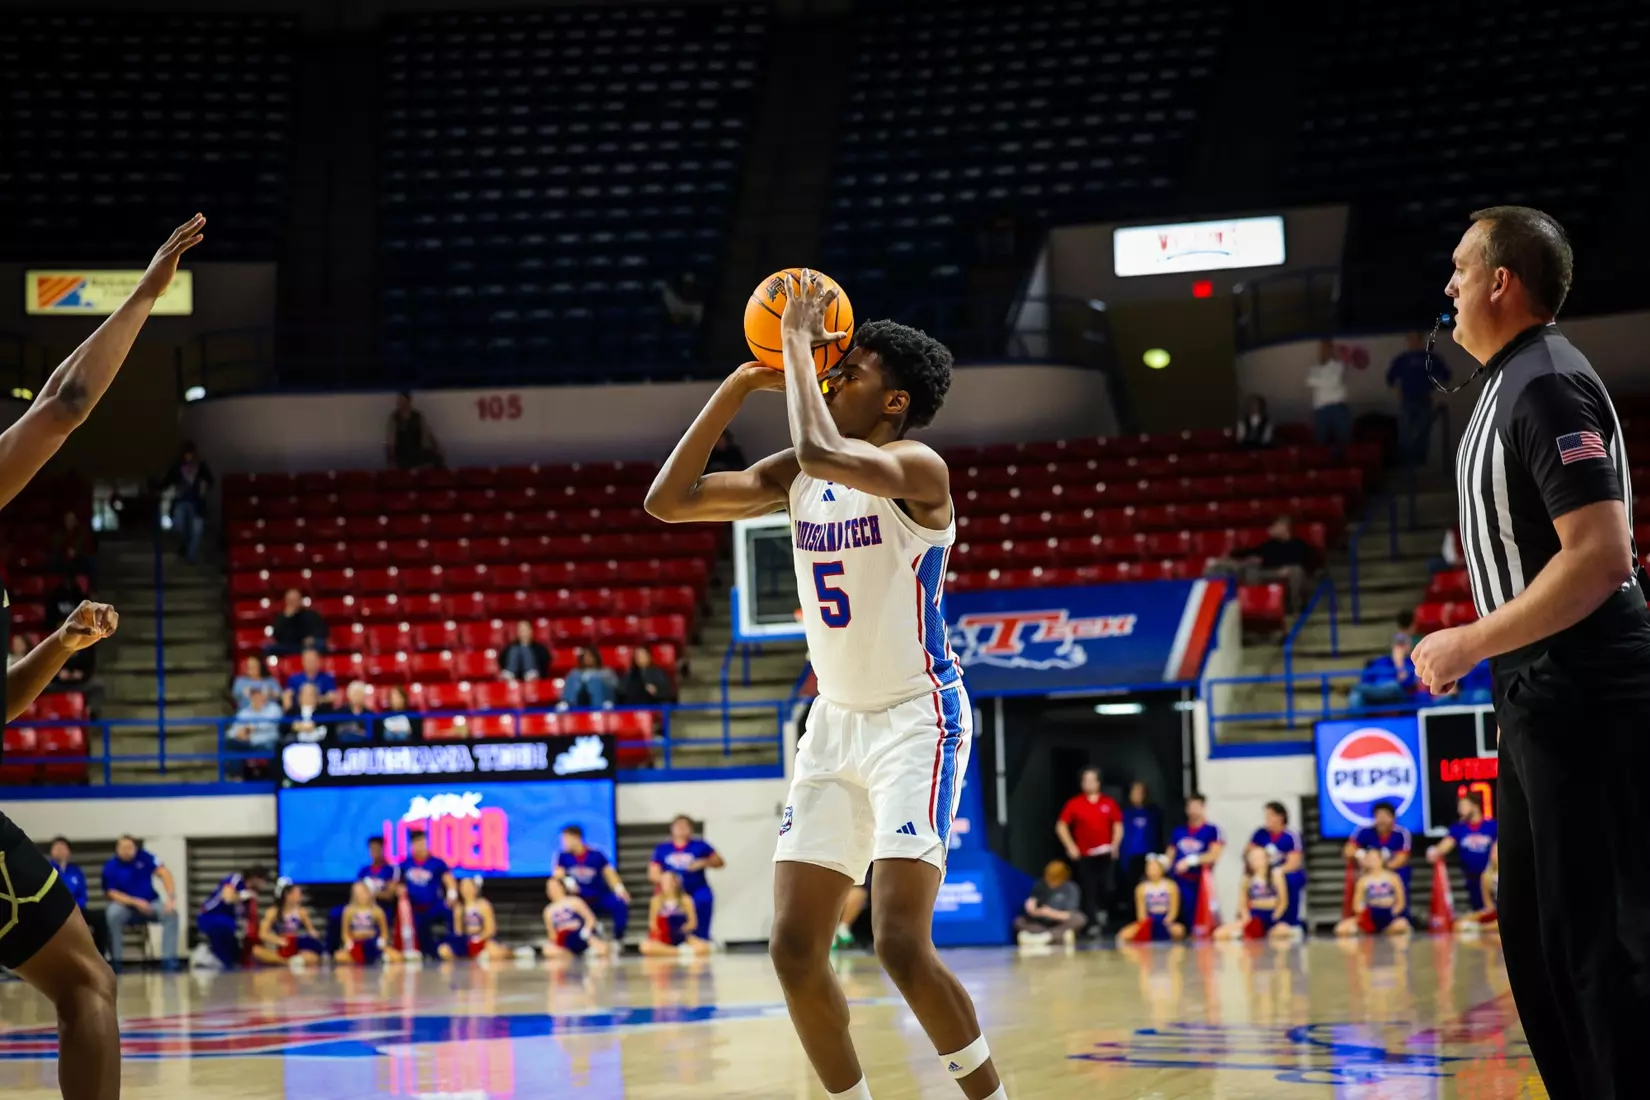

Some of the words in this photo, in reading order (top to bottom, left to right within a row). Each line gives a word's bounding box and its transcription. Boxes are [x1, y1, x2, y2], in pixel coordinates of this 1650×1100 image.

[475, 394, 524, 421] 105
[812, 560, 851, 628] 5
[1334, 767, 1410, 787] PEPSI
